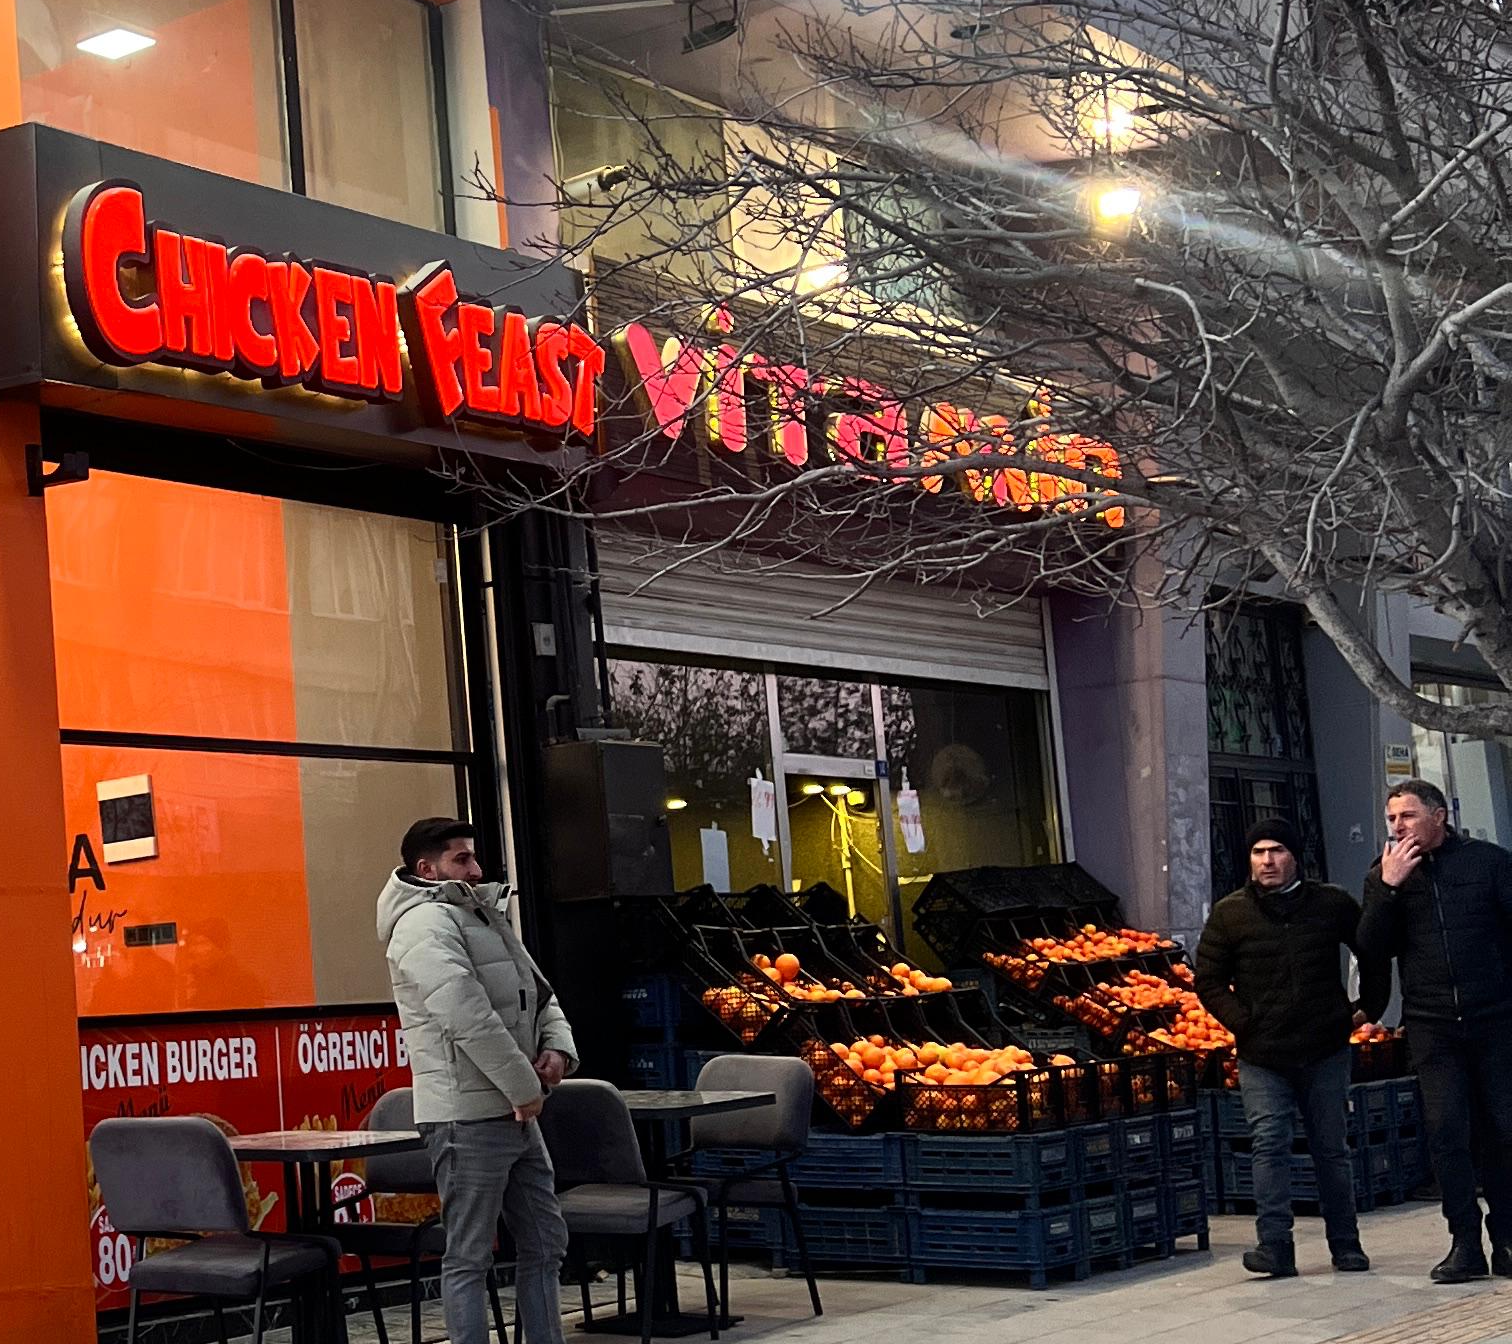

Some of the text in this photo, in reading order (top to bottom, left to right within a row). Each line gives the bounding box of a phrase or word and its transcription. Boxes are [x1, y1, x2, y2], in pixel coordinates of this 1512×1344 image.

[76, 184, 606, 437] CHICKEN FEAST
[166, 1036, 258, 1085] BURGER
[298, 1020, 389, 1074] ÖĞRENCİ
[341, 1072, 386, 1120] Menü
[98, 1233, 132, 1285] 80
